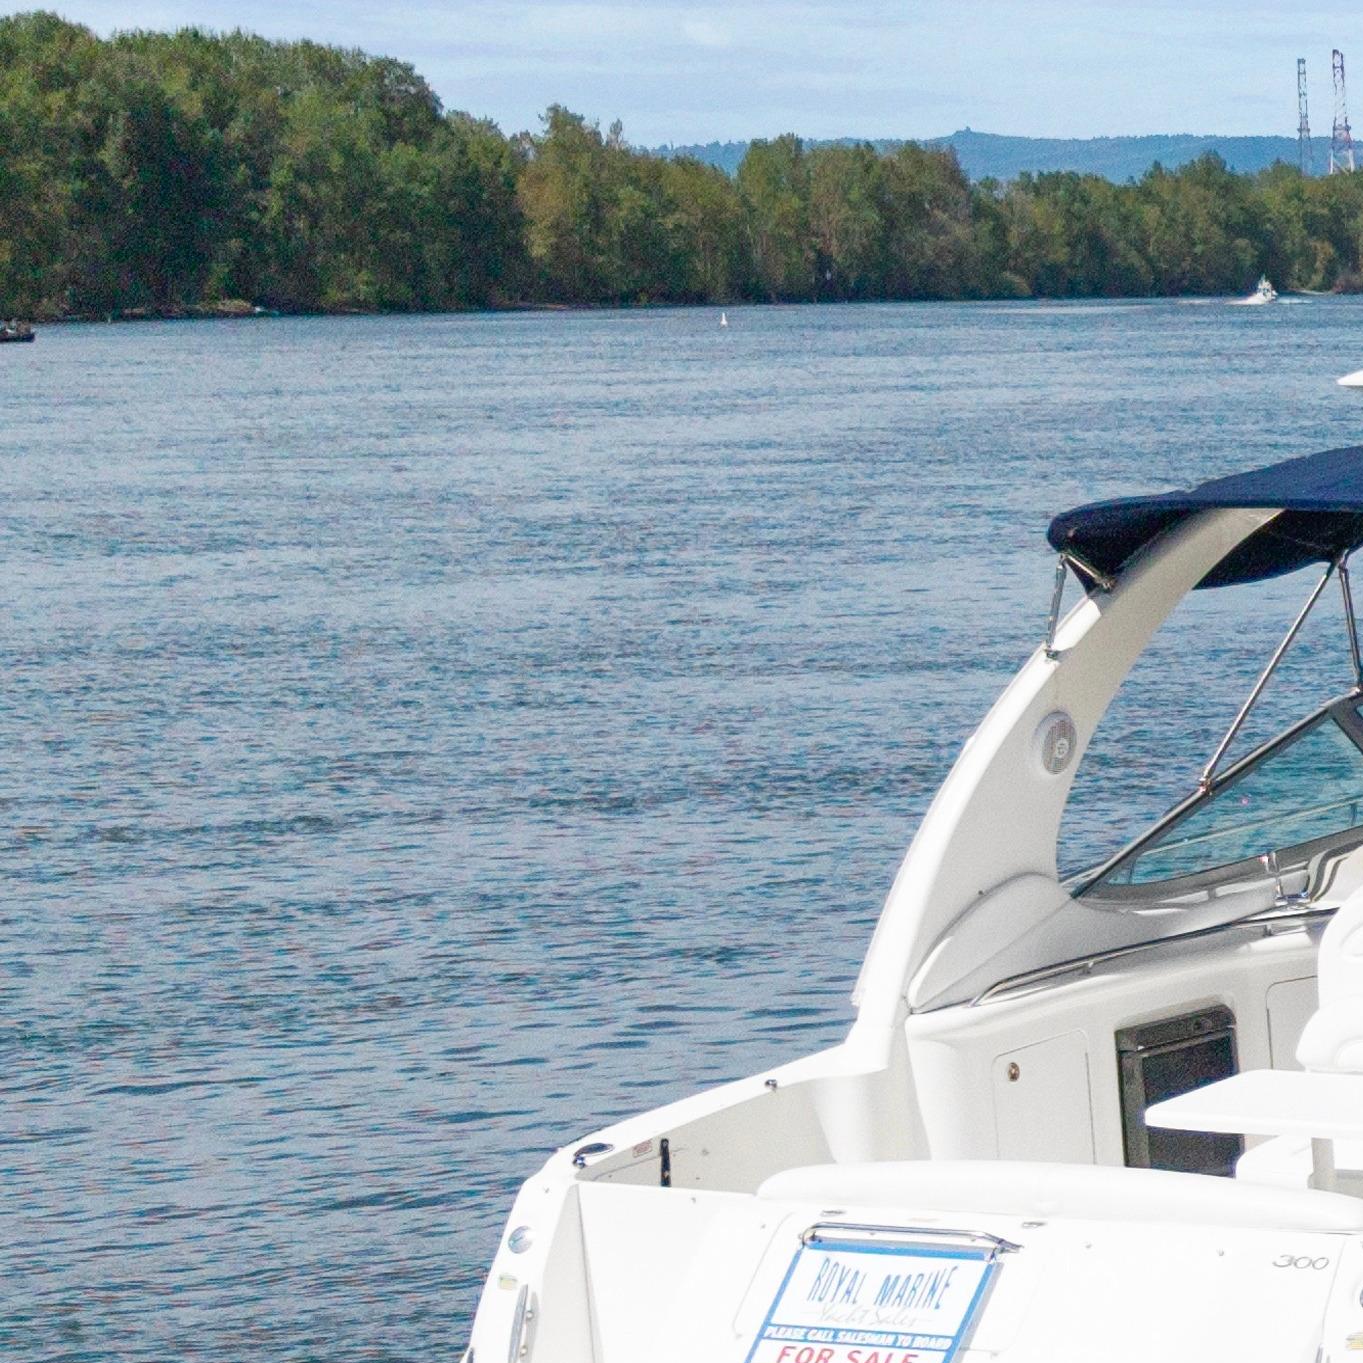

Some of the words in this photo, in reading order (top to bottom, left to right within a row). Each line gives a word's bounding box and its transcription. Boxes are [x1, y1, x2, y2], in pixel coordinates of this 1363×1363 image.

[1272, 1254, 1330, 1271] 300
[807, 1257, 867, 1304] ROYAL
[874, 1265, 959, 1311] MARINE
[766, 1327, 806, 1341] PLEASE
[807, 1328, 836, 1342] CALL
[837, 1331, 896, 1345] SALESMAN
[897, 1334, 911, 1347] TO
[912, 1336, 953, 1349] BOARD
